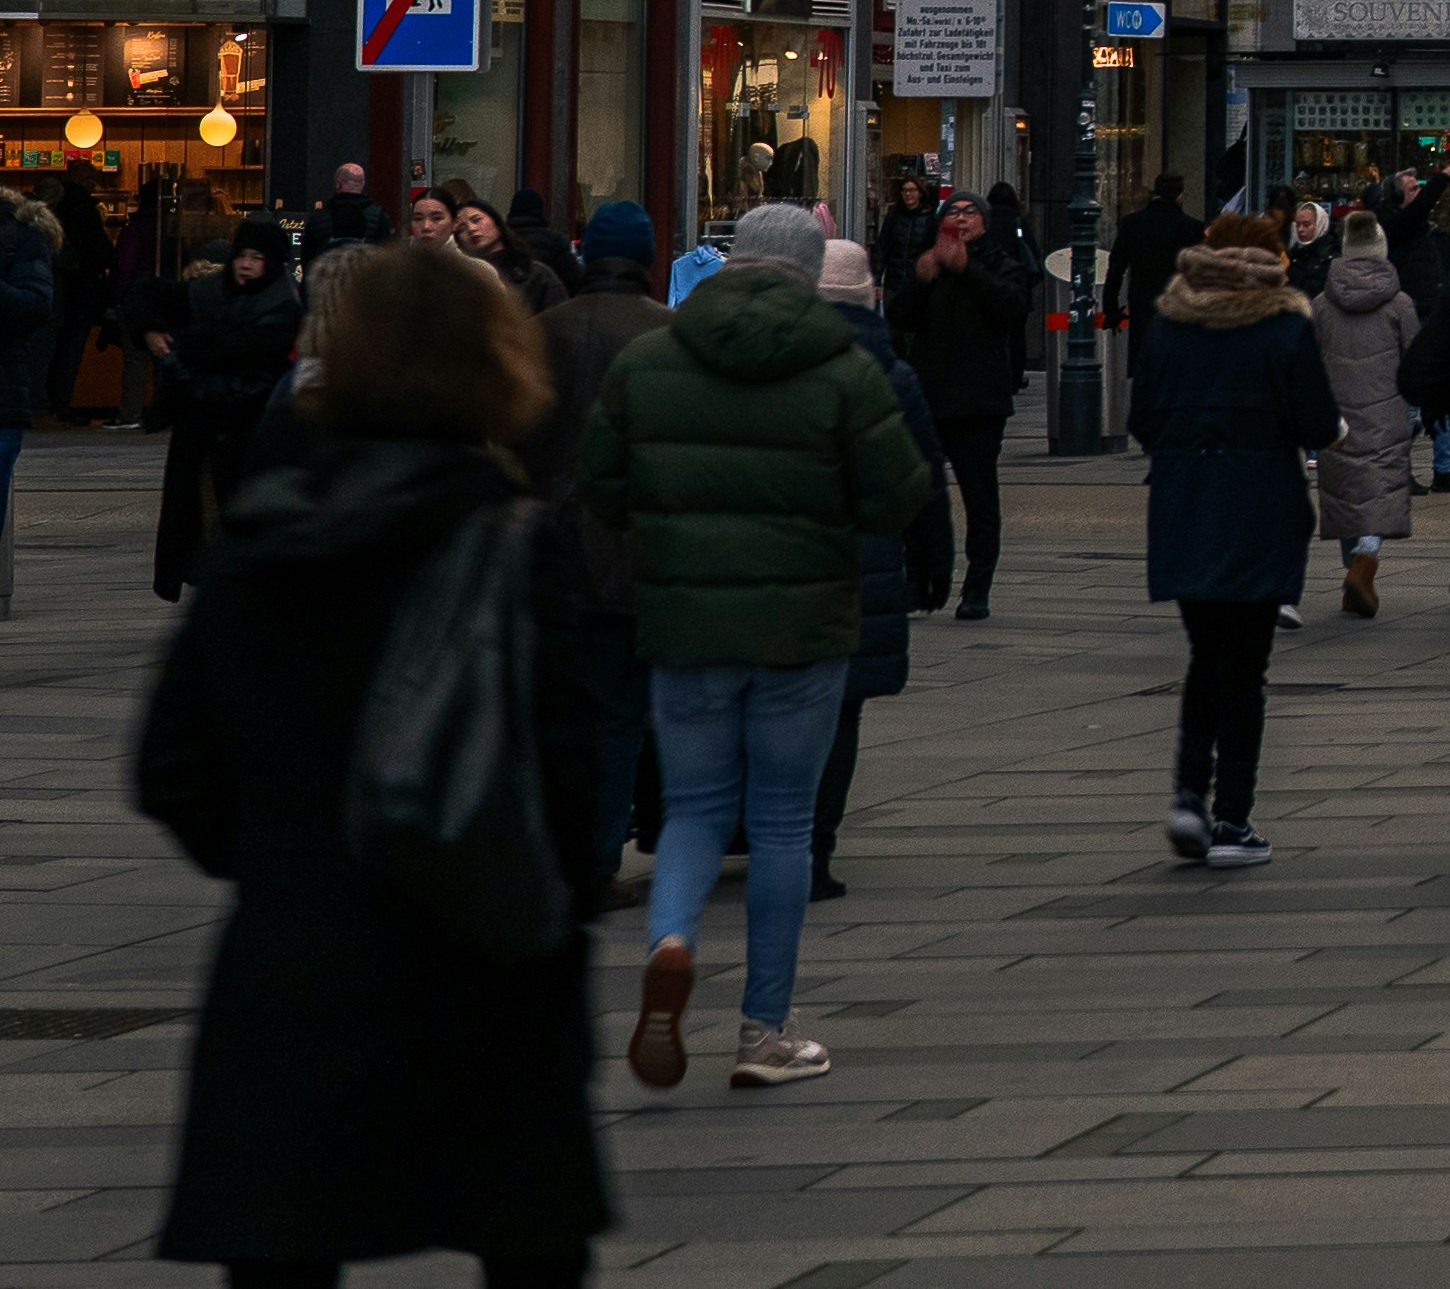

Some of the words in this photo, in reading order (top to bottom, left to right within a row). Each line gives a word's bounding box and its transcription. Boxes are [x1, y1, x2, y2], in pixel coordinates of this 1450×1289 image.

[920, 6, 974, 15] ausgenommen
[1115, 10, 1132, 29] WC
[898, 28, 926, 37] Zufahrt
[928, 29, 942, 37] zur
[904, 40, 917, 48] mit
[961, 40, 973, 48] bis
[920, 63, 934, 72] und
[936, 63, 952, 72] Taxi
[954, 64, 971, 72] zum
[927, 74, 941, 83] und
[943, 74, 983, 85] Einsteigen
